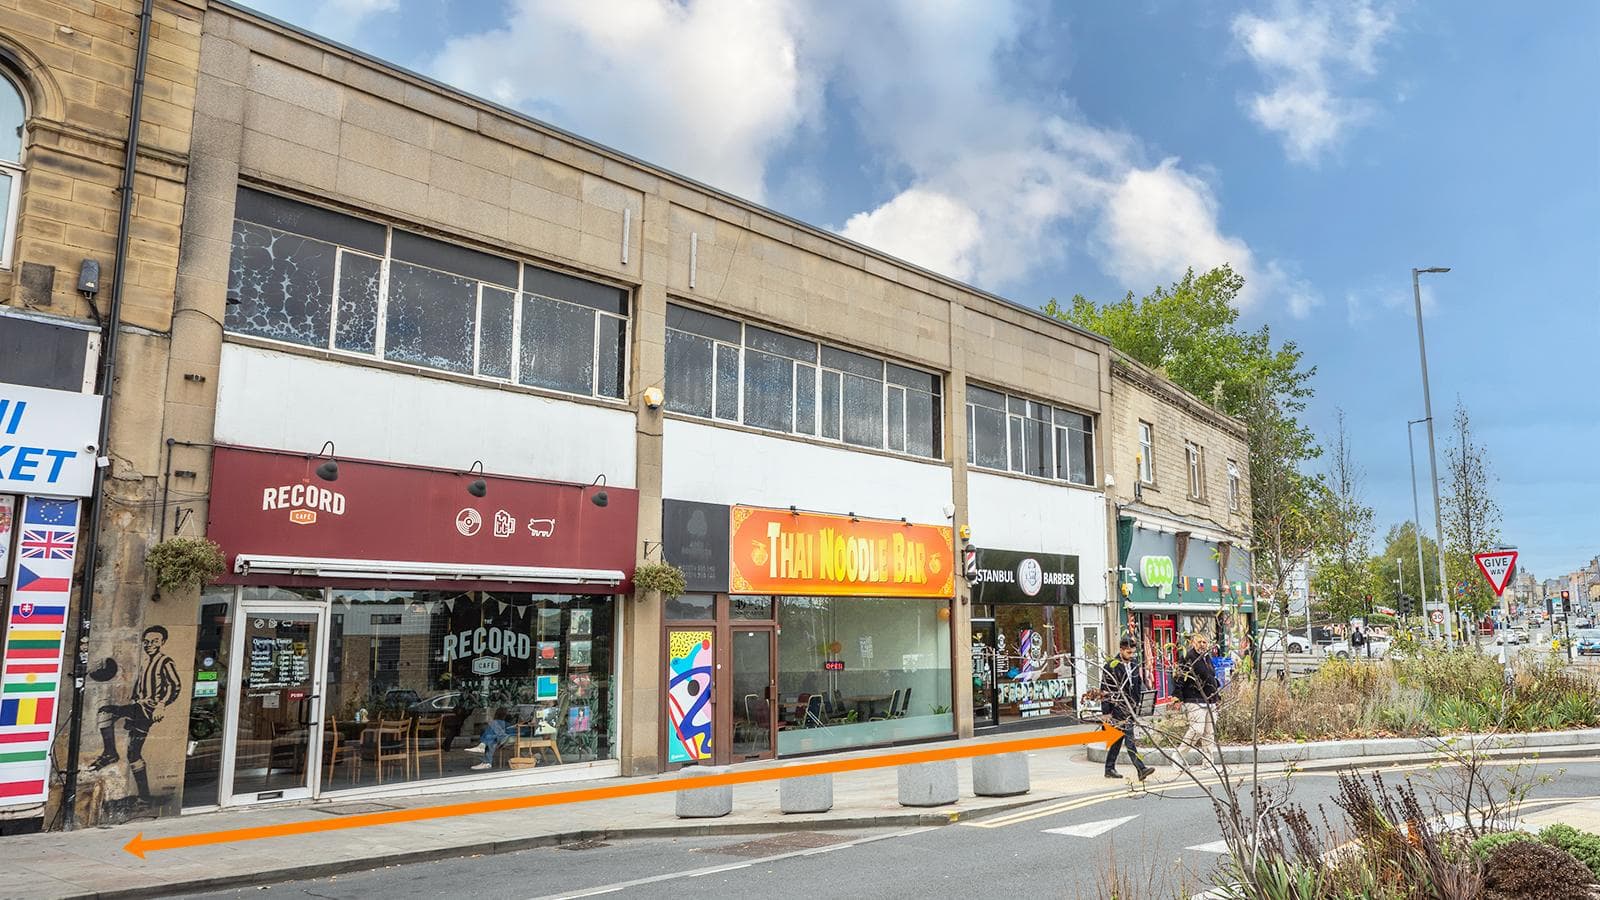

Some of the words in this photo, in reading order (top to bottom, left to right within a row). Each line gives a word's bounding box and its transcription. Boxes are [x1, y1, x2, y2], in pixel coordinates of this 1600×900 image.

[0, 399, 27, 435] I
[262, 484, 346, 516] RECORD
[767, 522, 814, 580] THAI
[819, 527, 889, 583] NOODLE
[892, 531, 928, 585] BAR
[1484, 557, 1509, 568] GIVE
[976, 569, 1014, 584] STANBUL
[1044, 574, 1074, 585] BARBERS
[442, 626, 531, 663] RECORD
